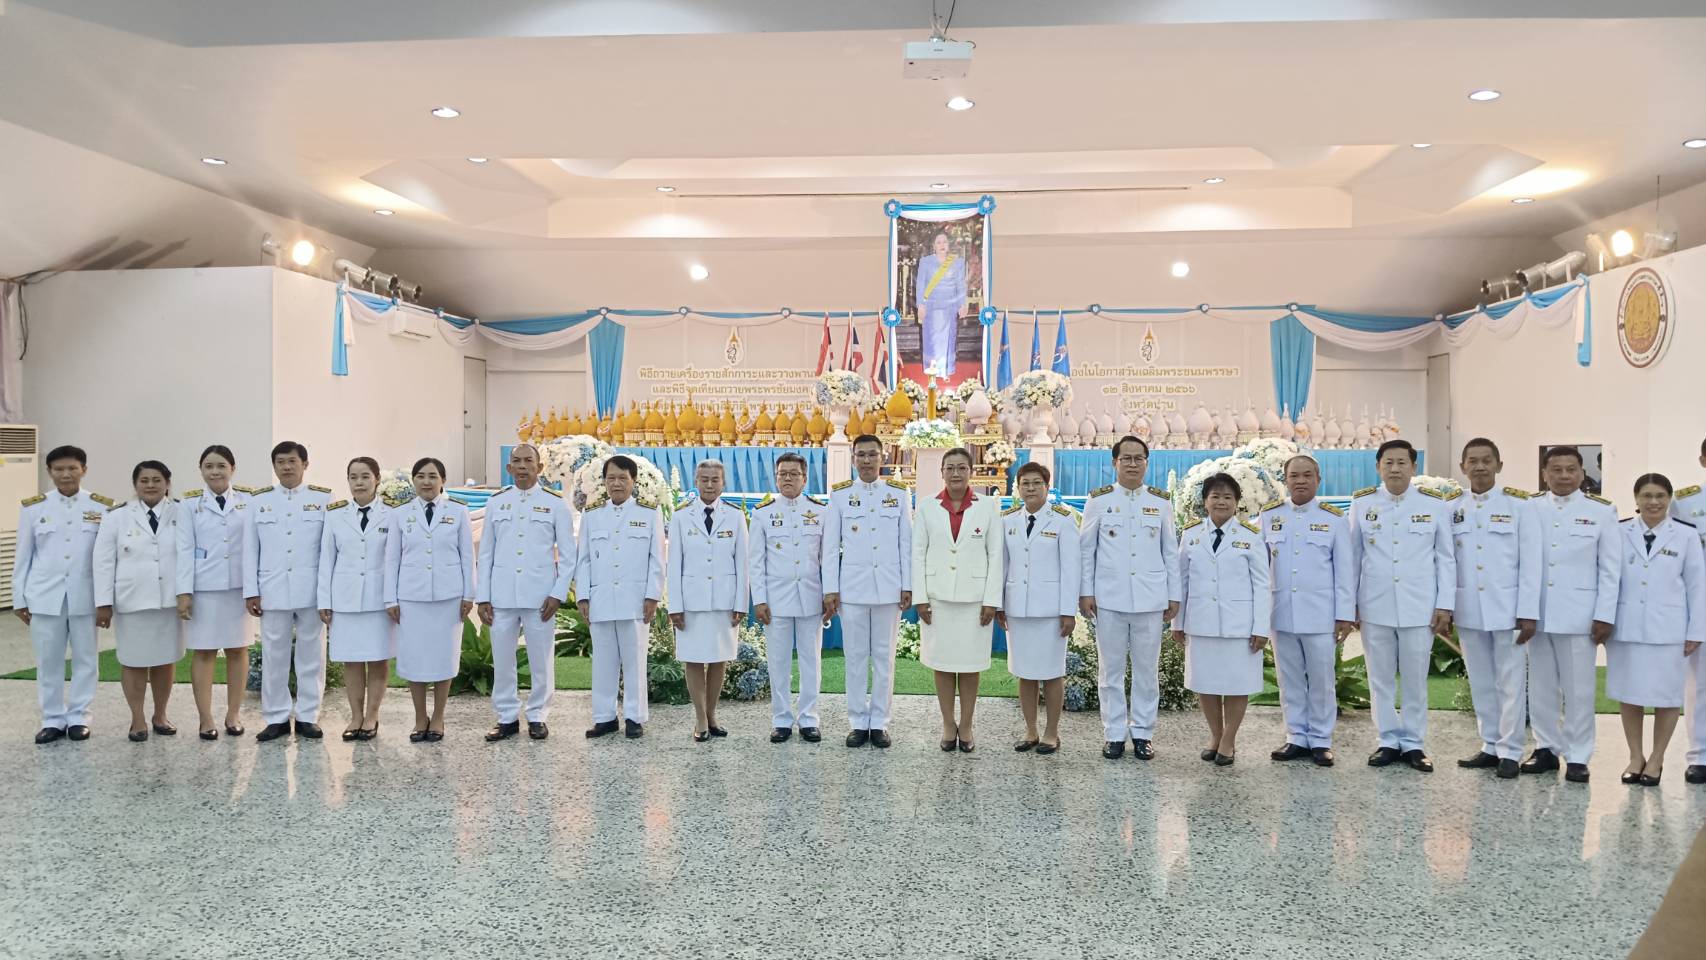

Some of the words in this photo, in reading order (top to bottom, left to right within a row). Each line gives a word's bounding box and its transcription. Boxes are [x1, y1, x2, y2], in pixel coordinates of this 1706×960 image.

[1072, 364, 1239, 377] องในโอกาสวันเฉลิมพระชนมพรรษา
[1122, 382, 1162, 394] สิงหาคม
